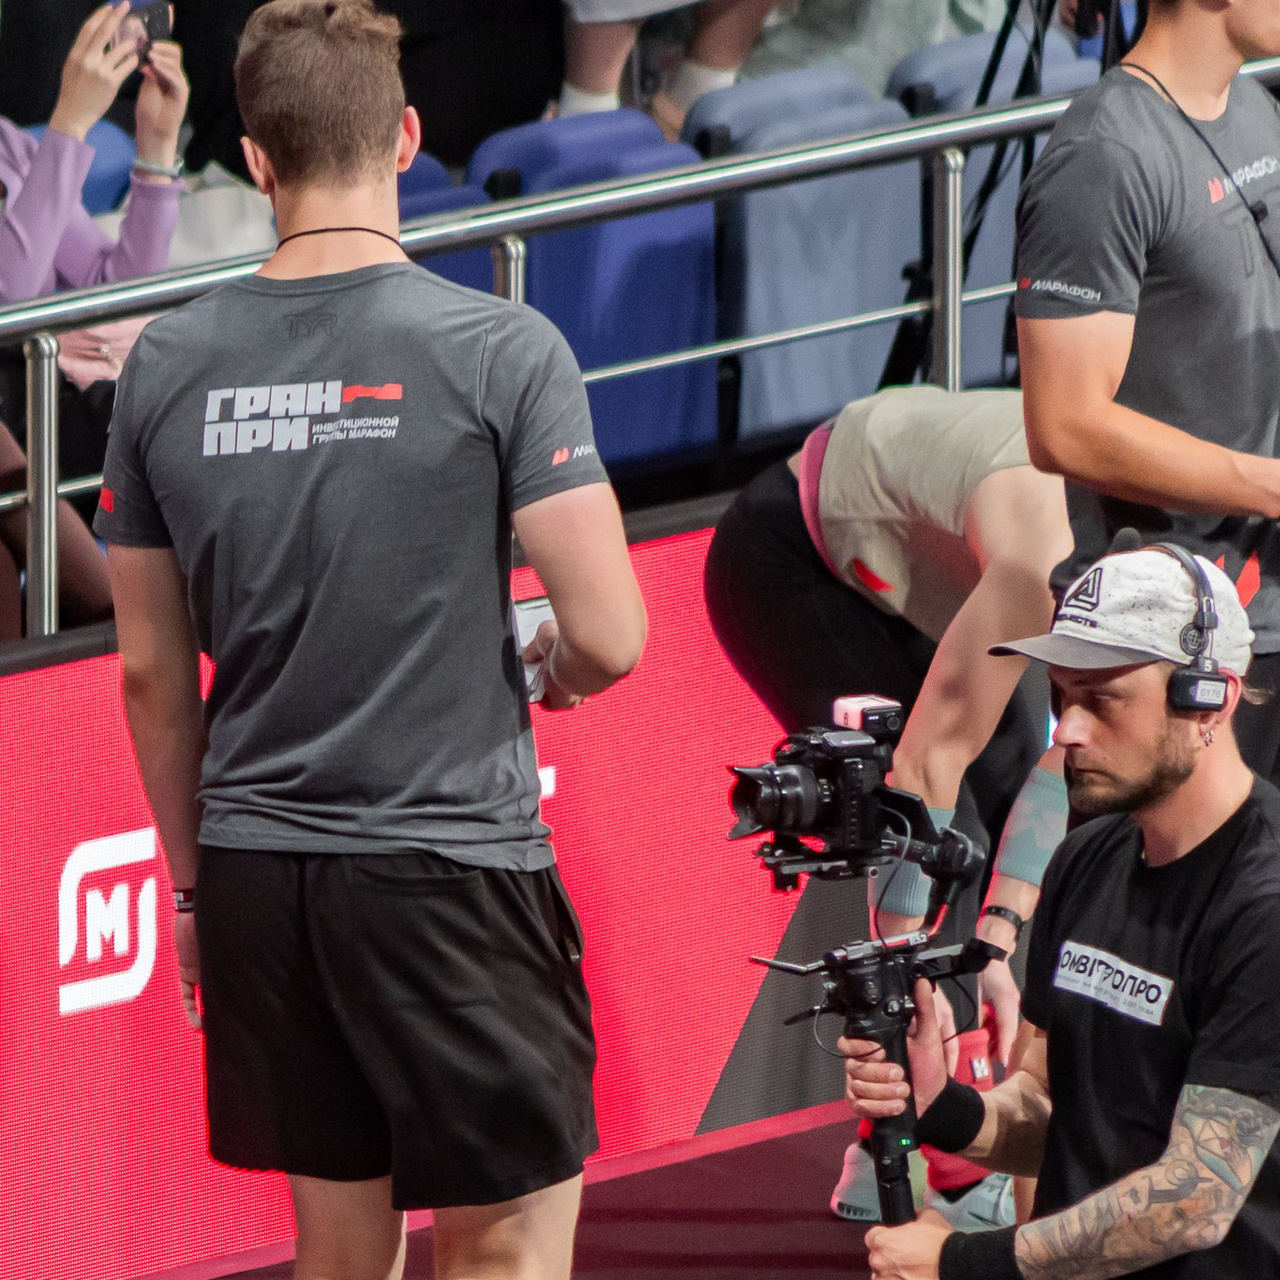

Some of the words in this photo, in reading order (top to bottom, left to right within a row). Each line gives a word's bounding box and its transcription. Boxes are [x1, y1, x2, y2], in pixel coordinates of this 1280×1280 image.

[1031, 279, 1102, 301] МАРАФОН
[205, 380, 342, 422] ГРАН
[203, 416, 310, 457] ПРИ
